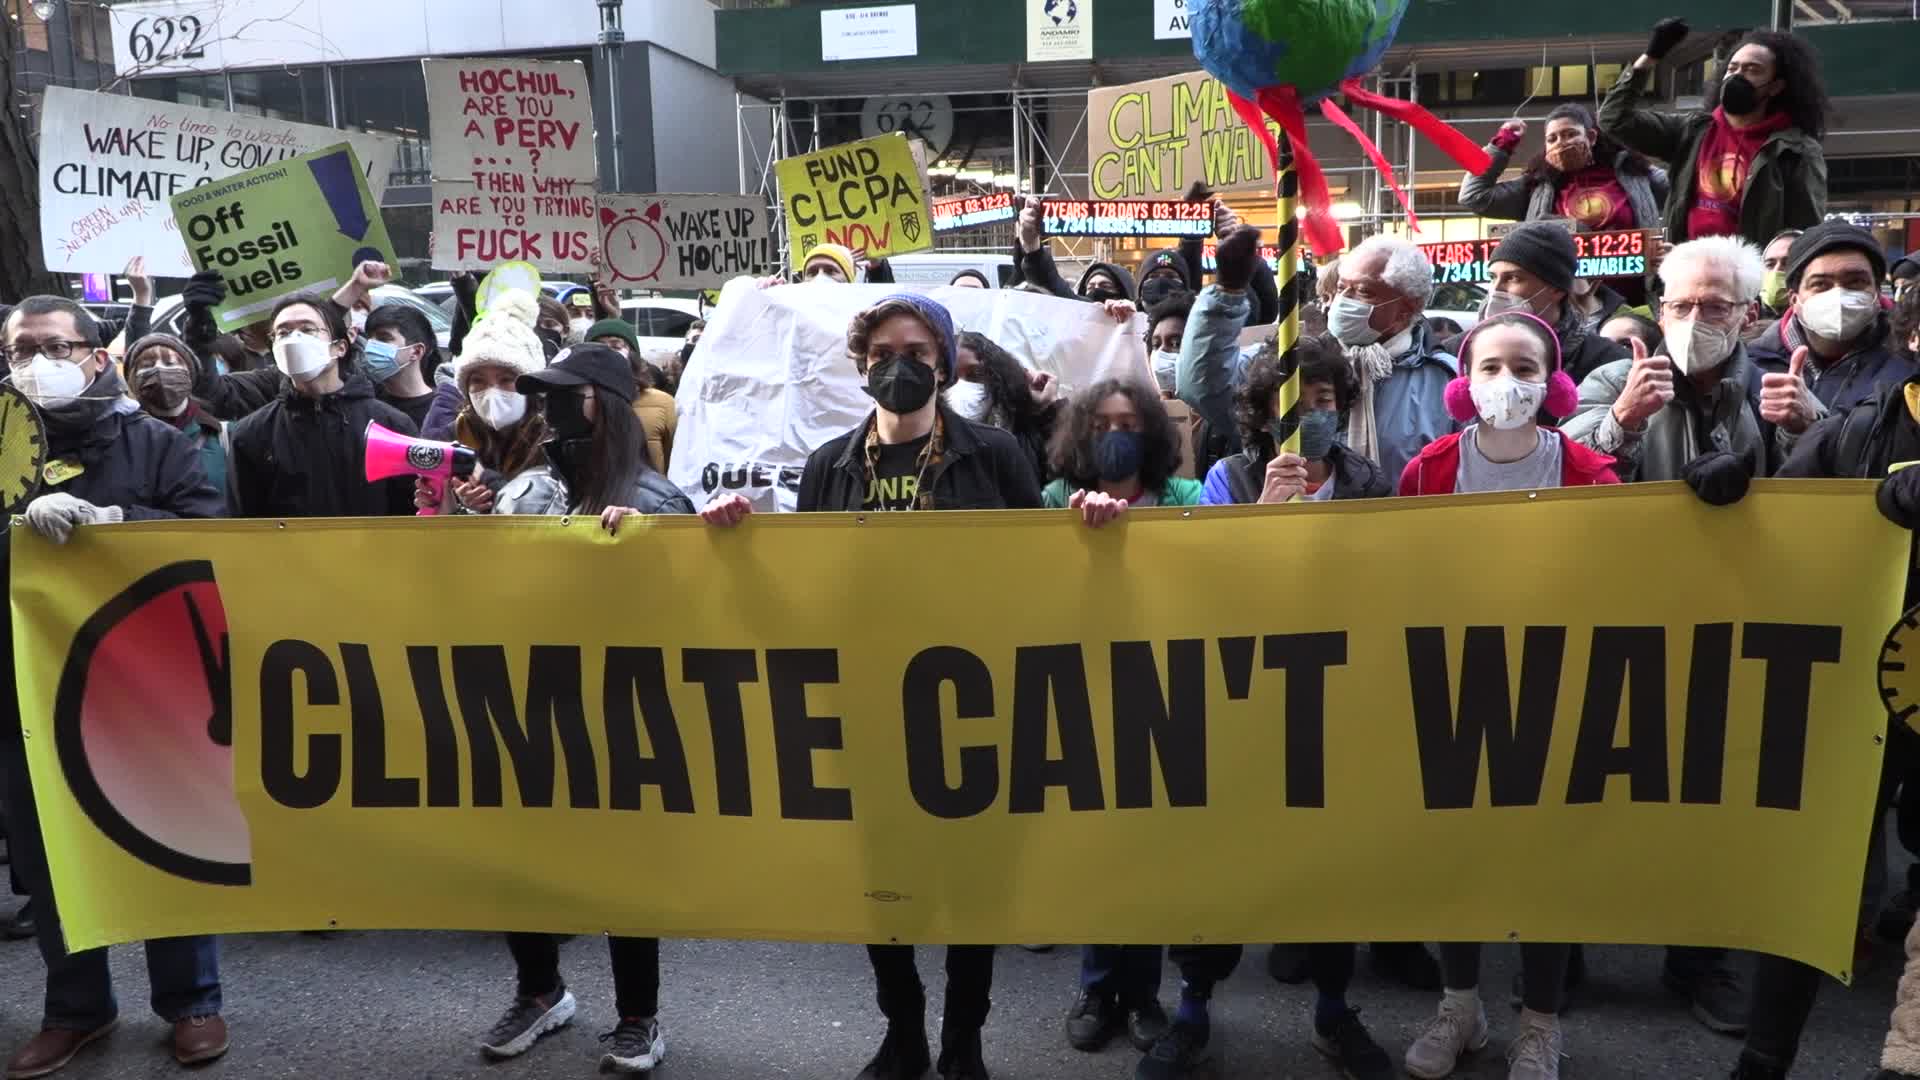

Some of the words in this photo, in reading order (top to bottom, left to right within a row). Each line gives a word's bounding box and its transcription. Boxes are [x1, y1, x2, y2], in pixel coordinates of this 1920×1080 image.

[128, 15, 204, 63] 622
[459, 69, 575, 99] HOCHUL,
[463, 95, 508, 116] ARE
[515, 95, 554, 117] YOU
[1108, 79, 1234, 149] CLIMA
[147, 115, 172, 129] No
[179, 118, 217, 135] time
[224, 124, 241, 138] to
[464, 119, 484, 139] A
[494, 117, 580, 150] PERV
[83, 123, 167, 159] WAKE
[177, 134, 215, 171] UP,
[472, 171, 525, 193] THEN
[533, 176, 576, 195] WHY
[805, 147, 880, 187] FUND
[1092, 140, 1190, 200] CAN'T
[178, 194, 205, 208] FOOD
[212, 182, 245, 198] WATER
[246, 168, 289, 188] ACTION!
[791, 172, 919, 227] CLCPA
[965, 193, 1011, 213] 03:12:23
[71, 205, 112, 237] GREEN
[188, 201, 245, 242] Off
[440, 196, 482, 215] ARE
[489, 196, 525, 213] YOU
[533, 196, 594, 218] TRYING
[502, 215, 526, 226] TO
[1152, 203, 1210, 219] 03:12:25
[67, 232, 92, 254] NEW
[93, 215, 121, 241] DEAL
[665, 208, 721, 242] WAKE
[724, 207, 755, 238] UP
[826, 221, 891, 250] NOW
[196, 220, 299, 272] Fossil
[457, 229, 543, 262] FUCK
[552, 231, 588, 261] US
[678, 237, 769, 277] HOCHUL!
[1574, 232, 1642, 257] 3:12:25
[223, 258, 303, 296] uels
[1576, 256, 1644, 277] EWABLES
[260, 638, 853, 820] CLIMATE
[902, 631, 1347, 819] CAN'T
[1405, 622, 1842, 811] WAIT
